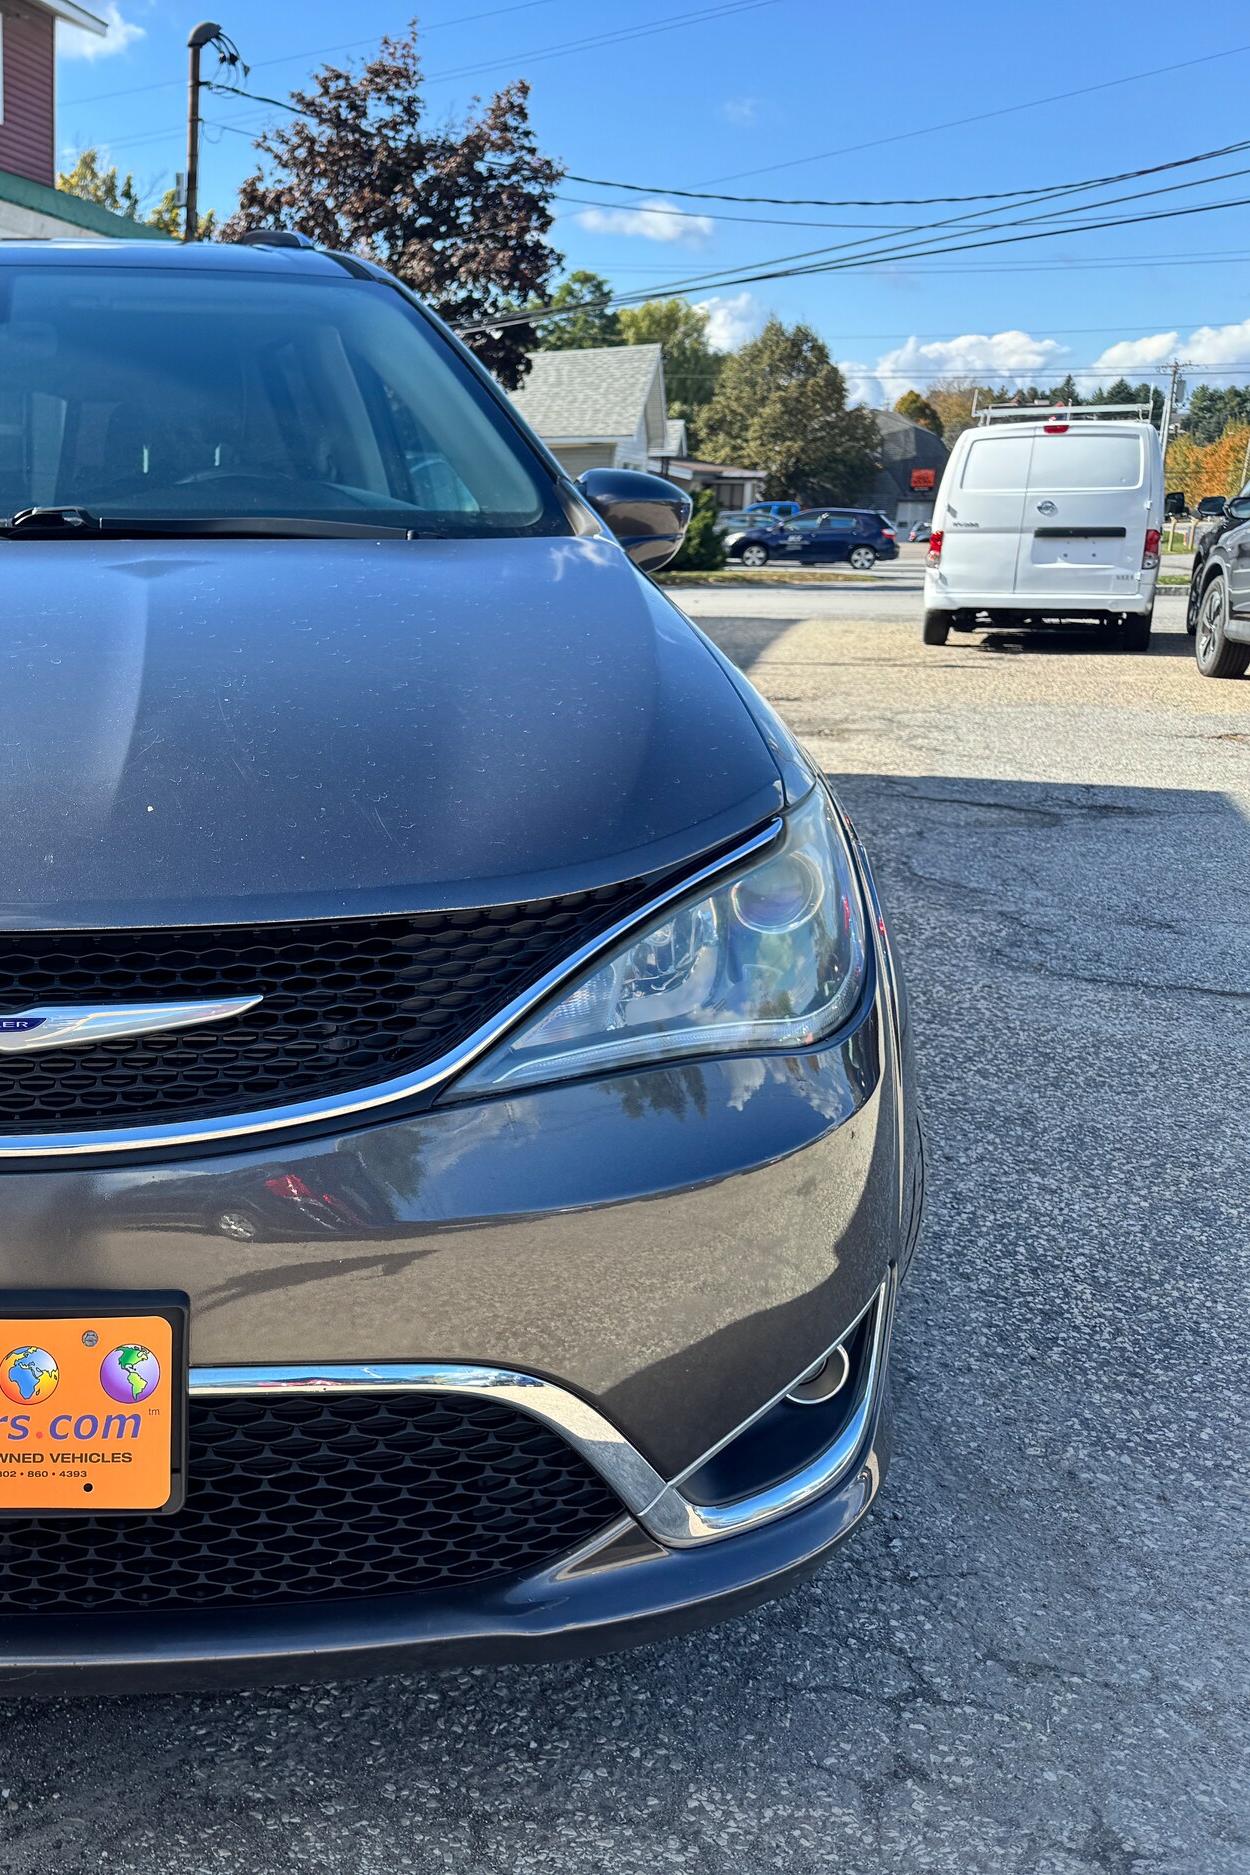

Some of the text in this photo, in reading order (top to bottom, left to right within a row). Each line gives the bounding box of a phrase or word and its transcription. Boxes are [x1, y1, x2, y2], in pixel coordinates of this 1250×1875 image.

[49, 1452, 133, 1464] VEHICLES
[27, 1470, 49, 1478] 860
[59, 1470, 87, 1478] 4393
